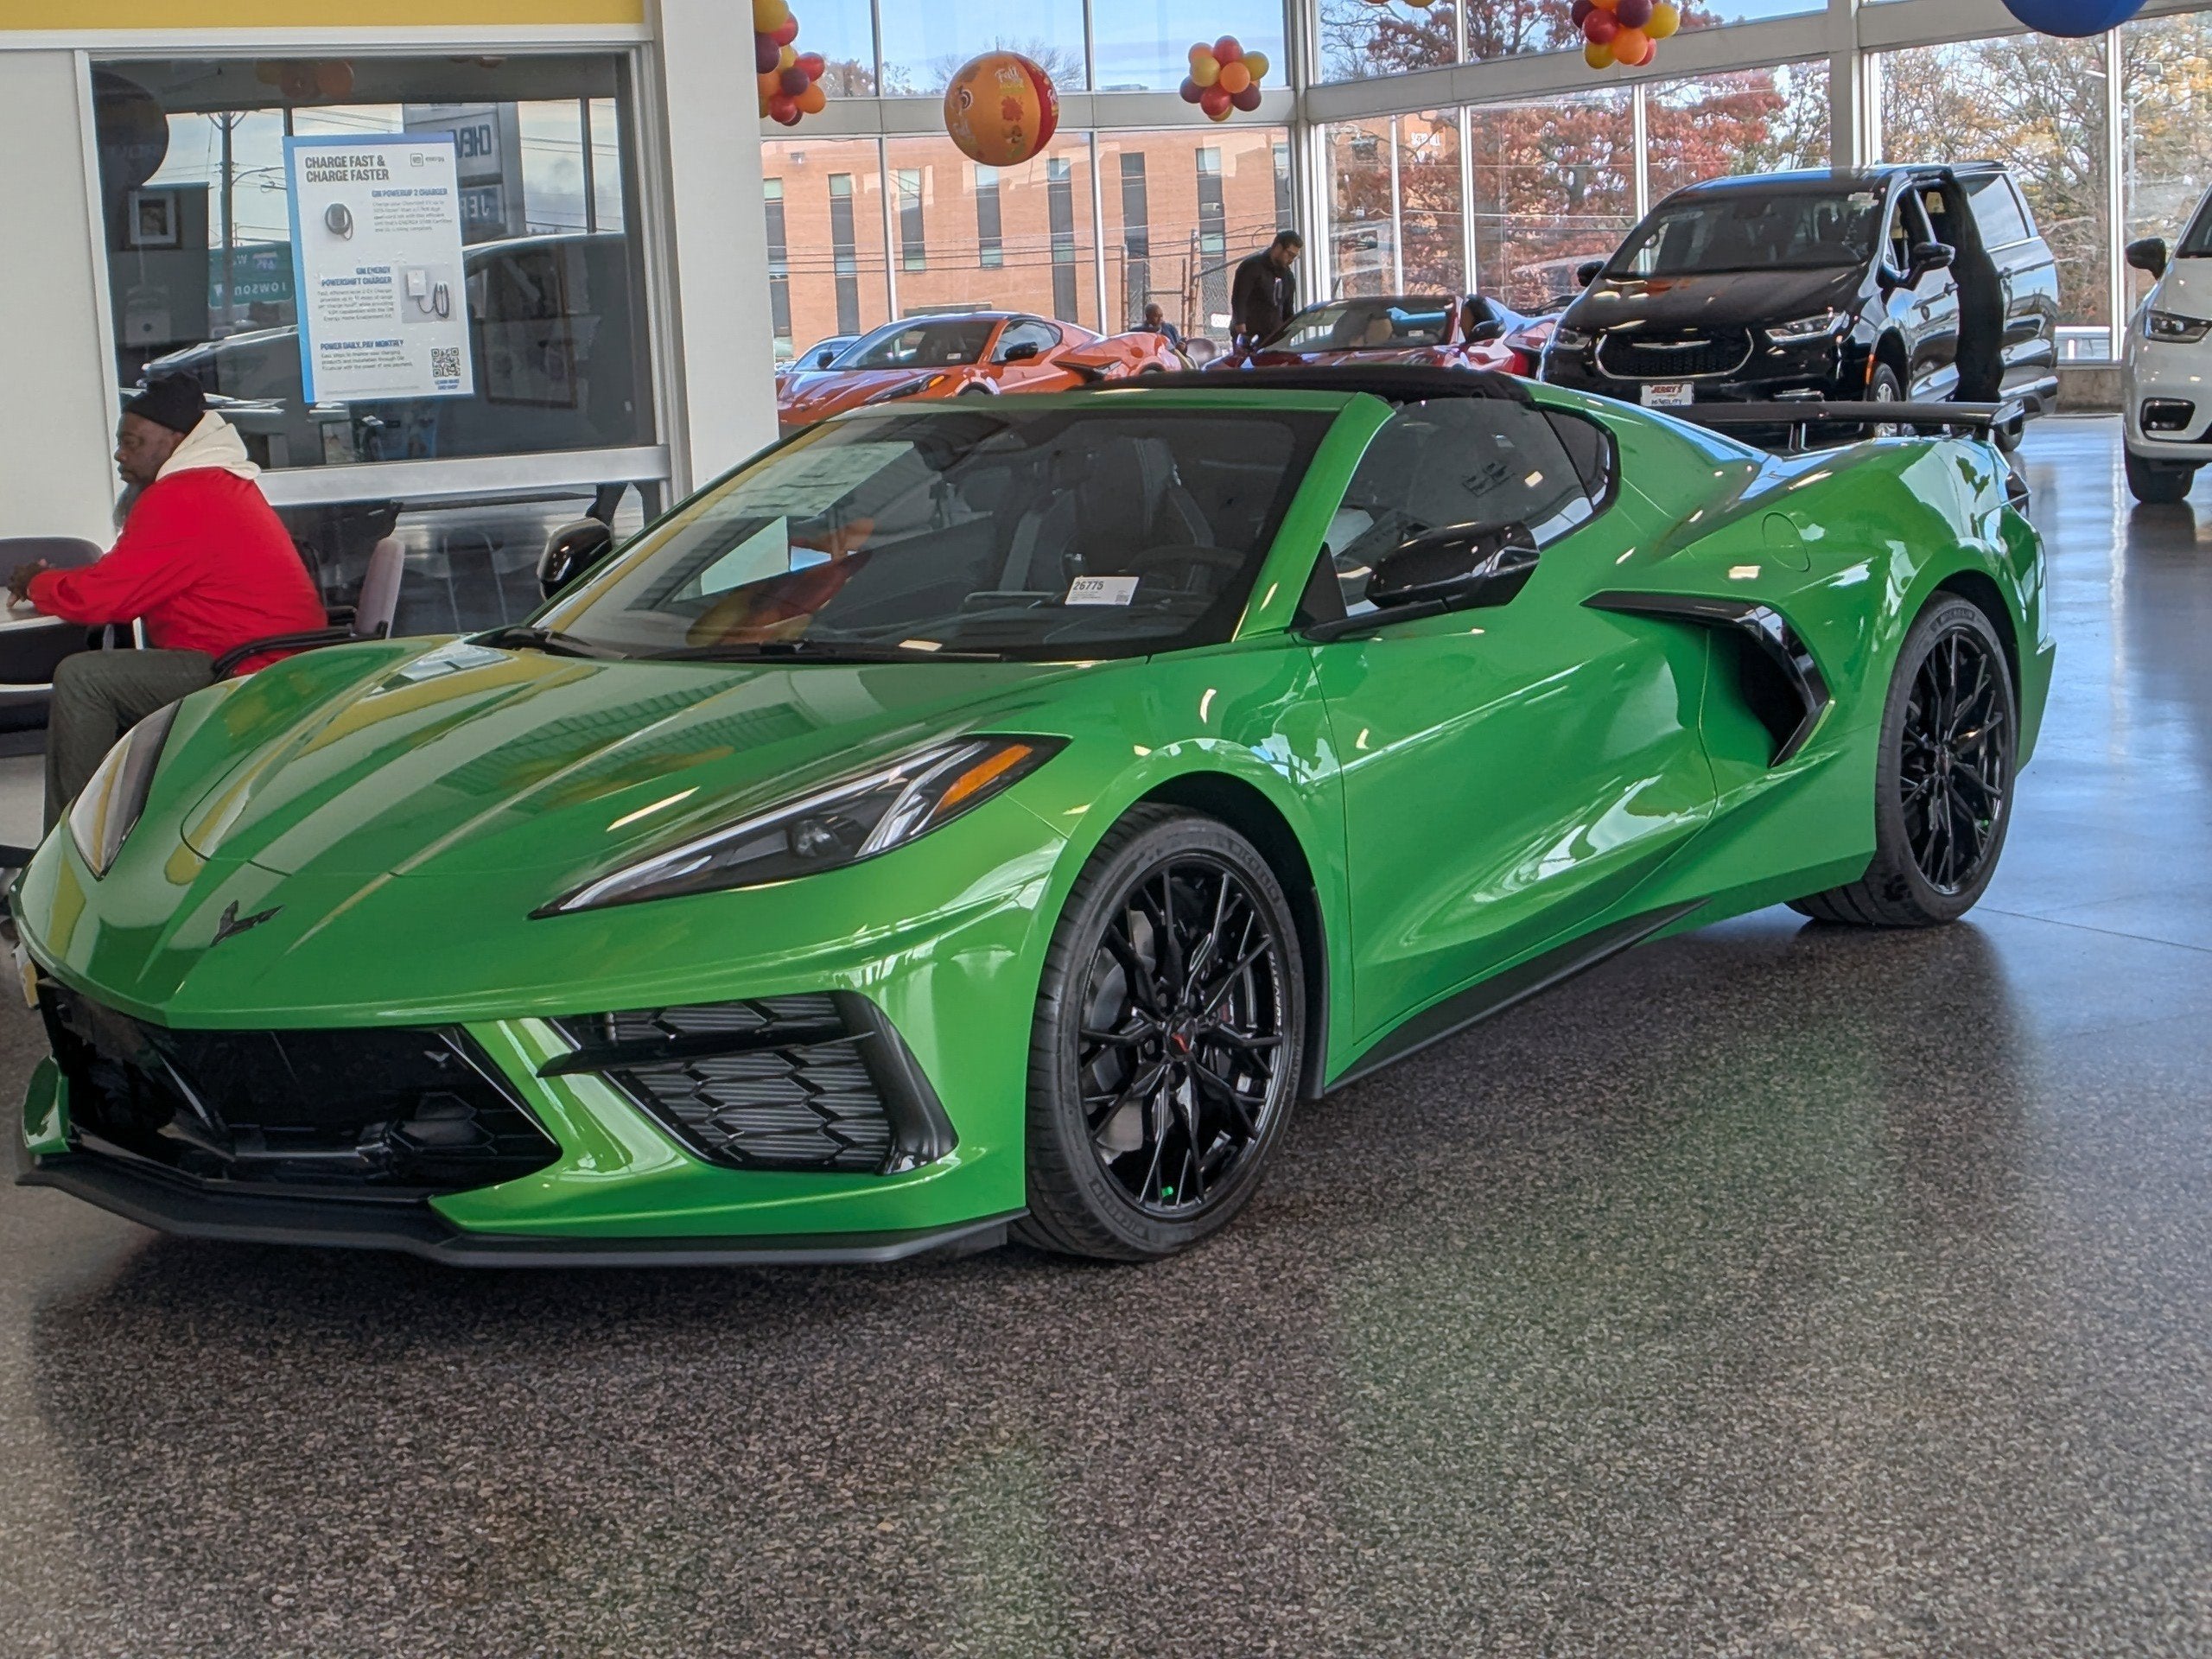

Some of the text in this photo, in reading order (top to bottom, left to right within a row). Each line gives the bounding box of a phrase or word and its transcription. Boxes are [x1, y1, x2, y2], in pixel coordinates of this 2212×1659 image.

[305, 155, 385, 168] CHARGE FAST &
[306, 168, 390, 182] CHARGE FASTER
[1073, 581, 1103, 590] 26775
